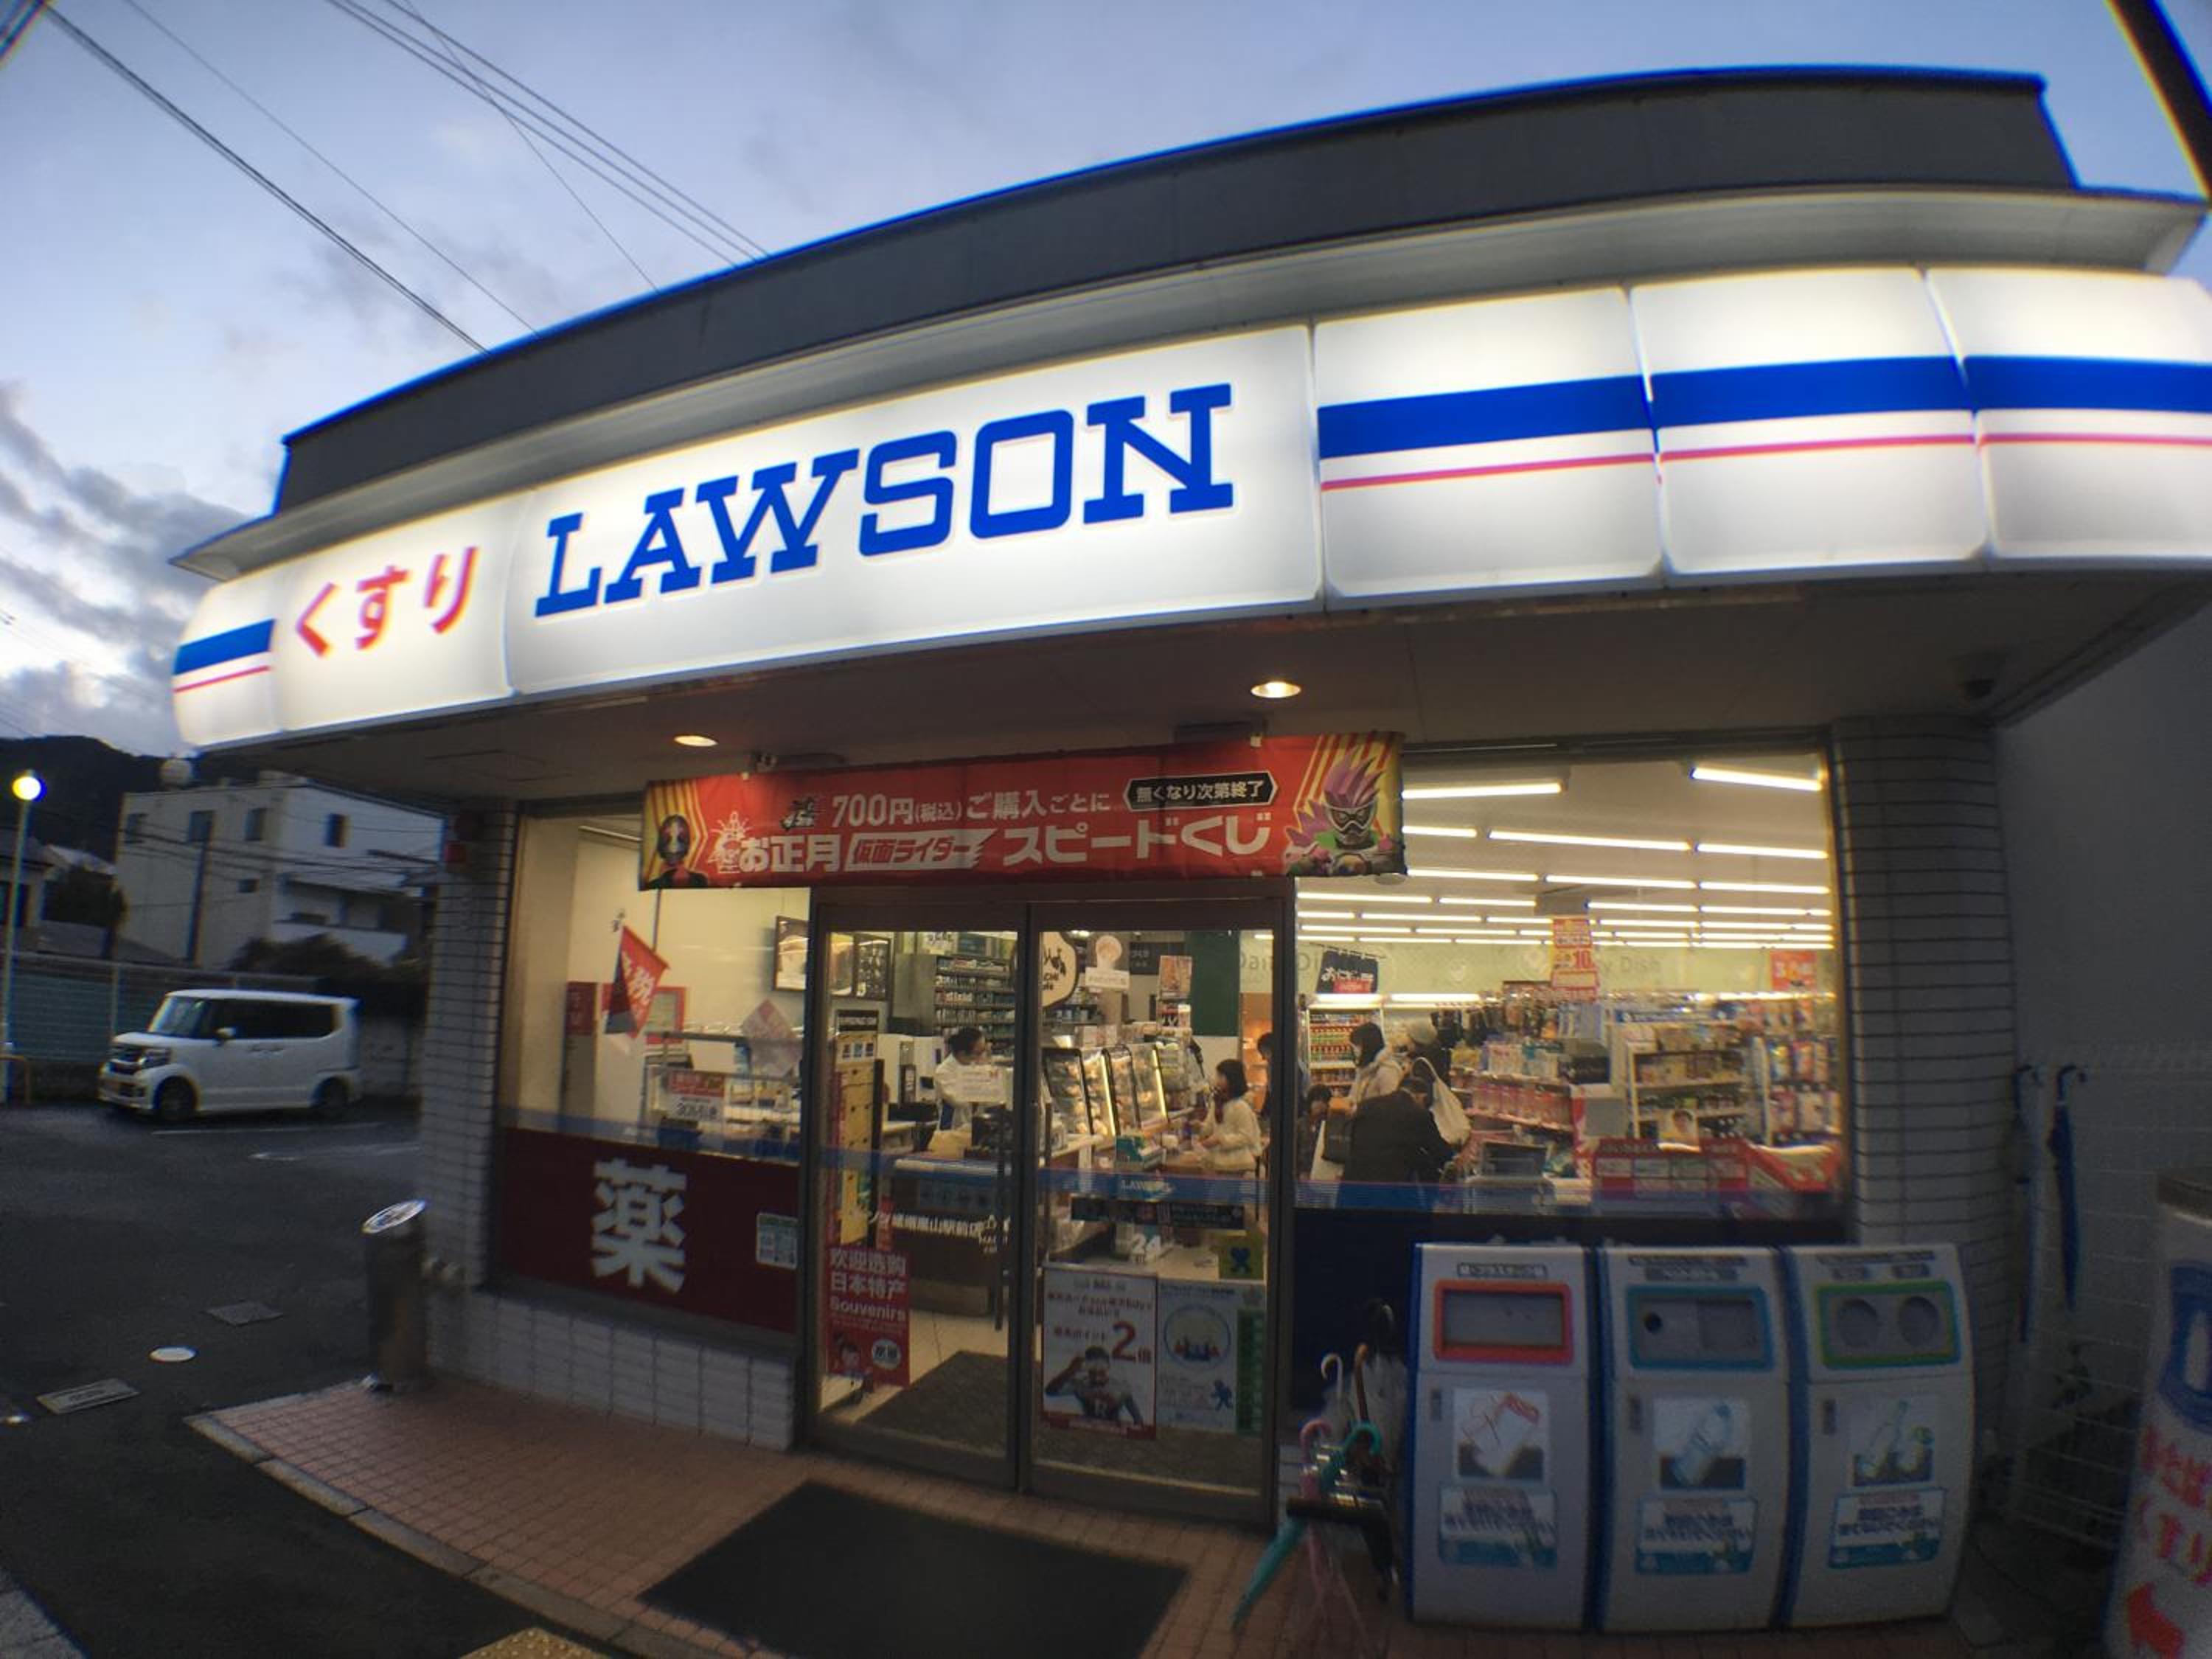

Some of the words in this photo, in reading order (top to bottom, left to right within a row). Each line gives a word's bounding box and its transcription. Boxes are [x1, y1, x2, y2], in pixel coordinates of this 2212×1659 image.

[535, 383, 1234, 618] LAWSON
[295, 547, 478, 656] くすり
[1135, 779, 1265, 803] 無くなり次第終了
[591, 1158, 687, 1295] 薬
[830, 1295, 906, 1323] Souvenirs
